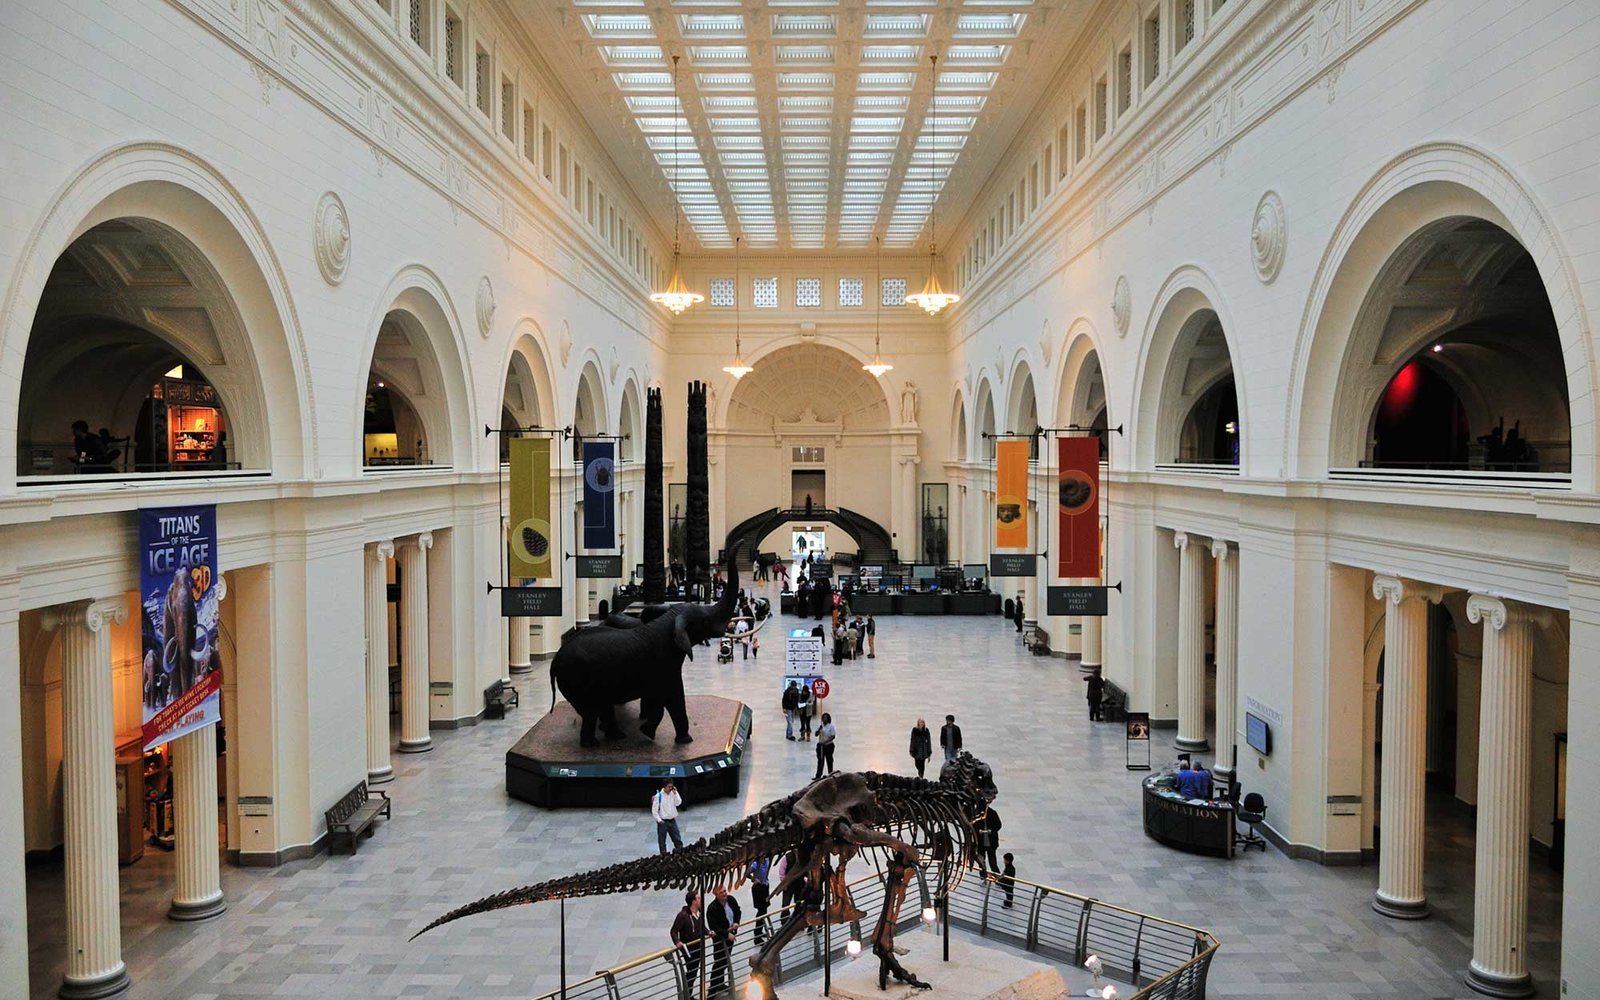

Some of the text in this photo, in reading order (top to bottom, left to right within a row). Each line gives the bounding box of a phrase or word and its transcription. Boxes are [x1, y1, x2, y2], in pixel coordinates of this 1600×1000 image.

[159, 515, 200, 538] TITANS
[171, 536, 190, 545] OF THE
[149, 544, 209, 576] ICE AGE
[191, 565, 211, 601] 3D
[153, 676, 212, 726] FOR TODAY'S VIEWING LOCATION
[158, 716, 172, 732] CHECK
[177, 706, 187, 717] ANY
[185, 695, 200, 710] TICKET
[199, 687, 210, 700] DESK
[1150, 797, 1219, 819] FORMATION
